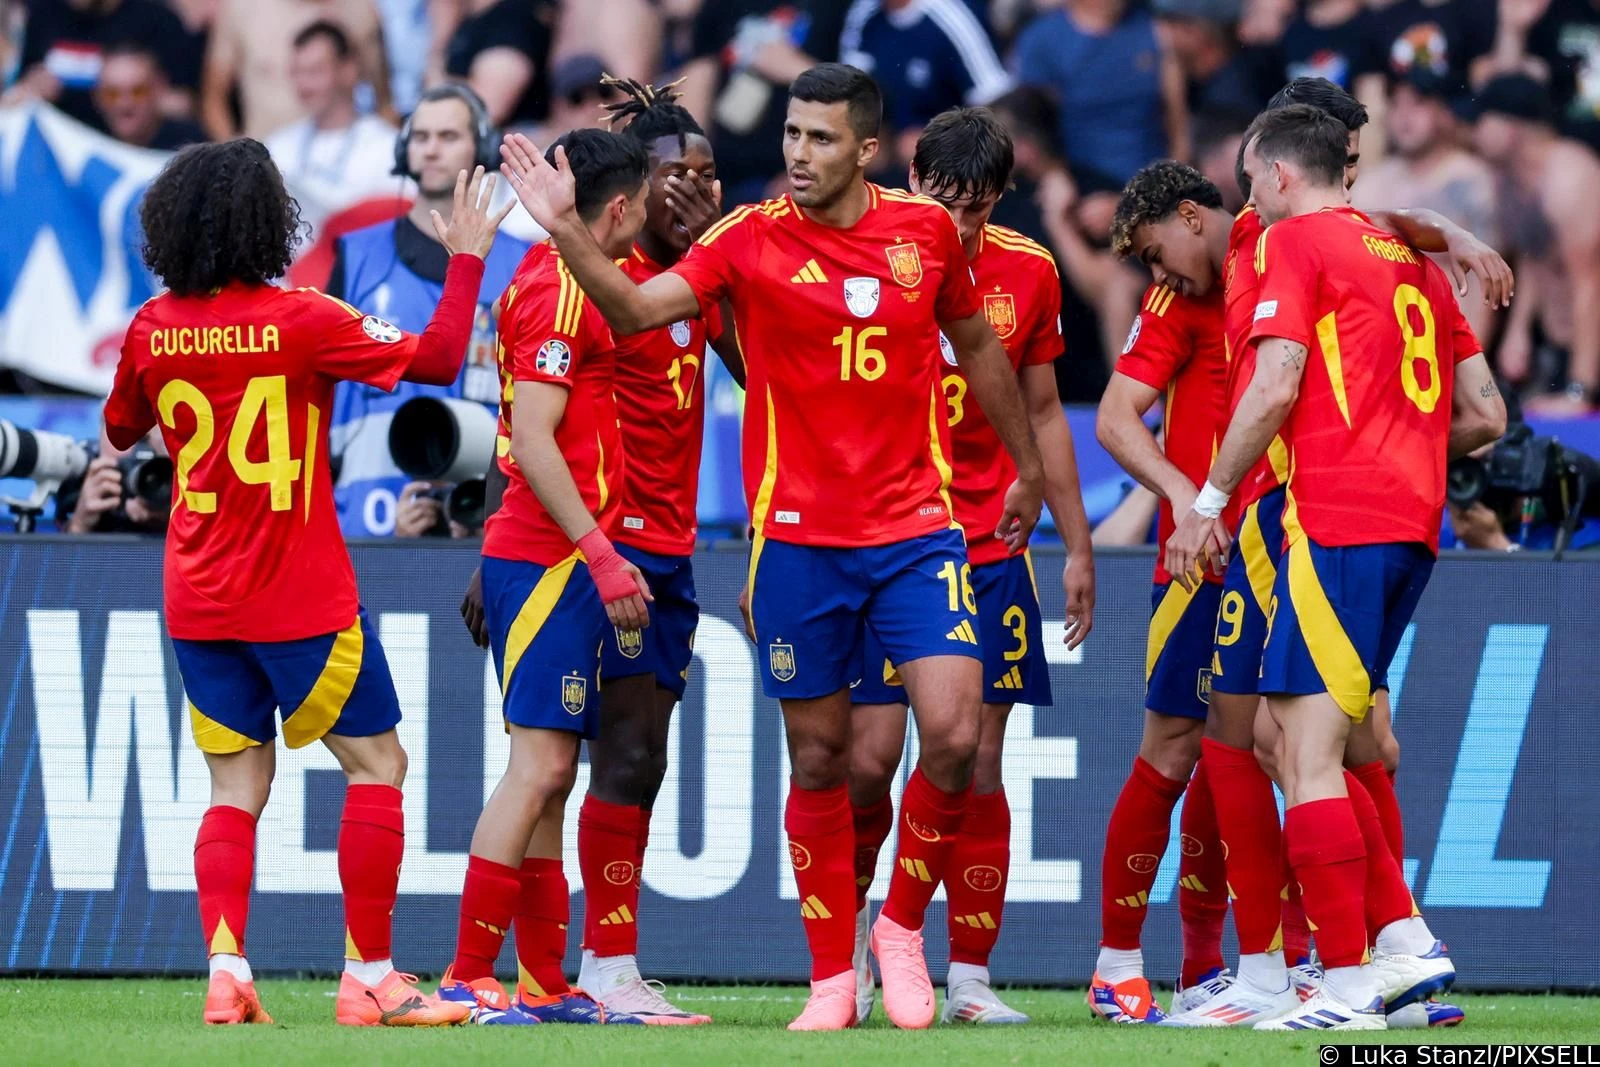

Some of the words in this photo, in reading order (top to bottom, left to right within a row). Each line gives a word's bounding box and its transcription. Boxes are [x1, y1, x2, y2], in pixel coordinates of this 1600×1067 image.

[151, 324, 279, 357] CUCURELLA
[832, 326, 887, 381] 16
[1393, 283, 1441, 414] 8
[666, 353, 700, 410] 17
[941, 374, 968, 427] 3
[157, 375, 301, 514] 24
[936, 560, 978, 616] 16
[1002, 604, 1028, 661] 3
[1213, 588, 1246, 647] 9
